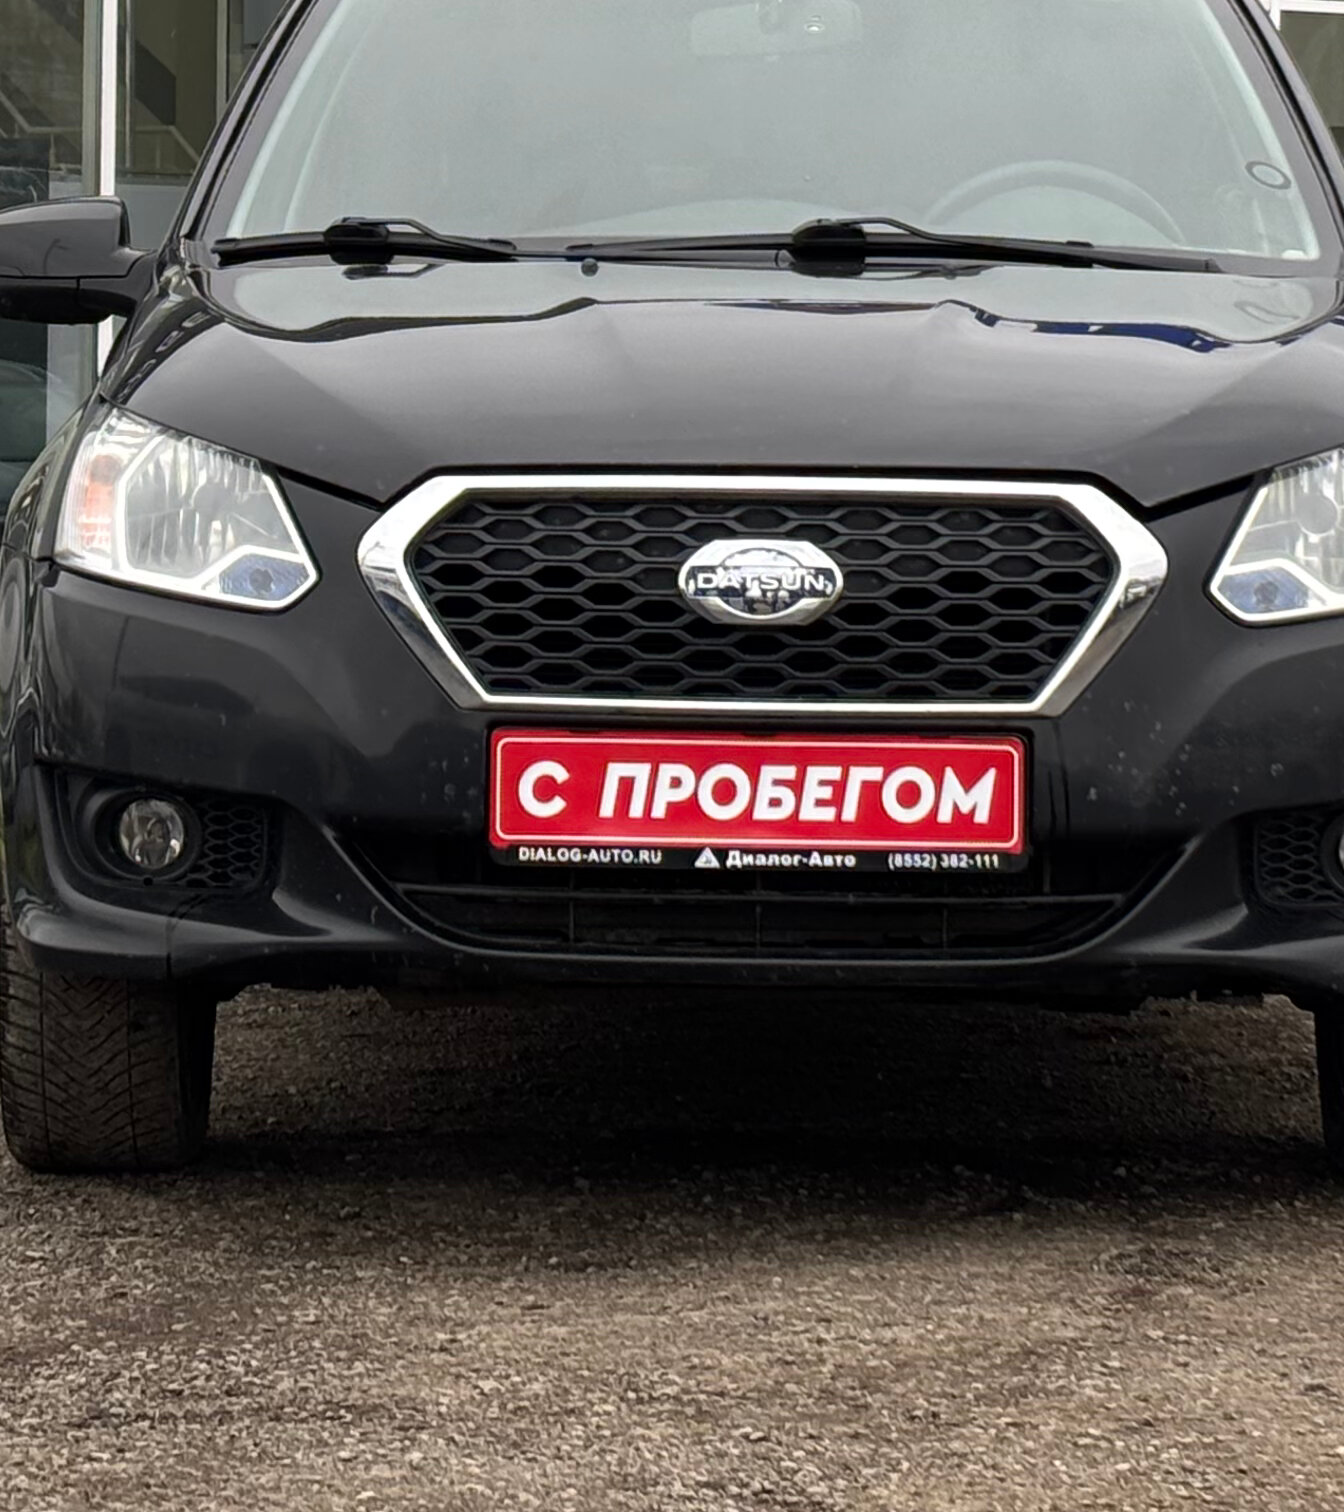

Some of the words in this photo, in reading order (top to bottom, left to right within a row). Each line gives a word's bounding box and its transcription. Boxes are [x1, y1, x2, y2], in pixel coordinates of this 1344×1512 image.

[697, 572, 825, 591] DATSUN
[517, 759, 571, 820] С
[598, 761, 997, 825] ПРОБЕГОМ
[518, 846, 663, 865] DIALOG-AUTO.RU
[725, 849, 856, 869] Диалог-Авто
[887, 852, 937, 871] (8552)
[940, 853, 1000, 870] 382-111
